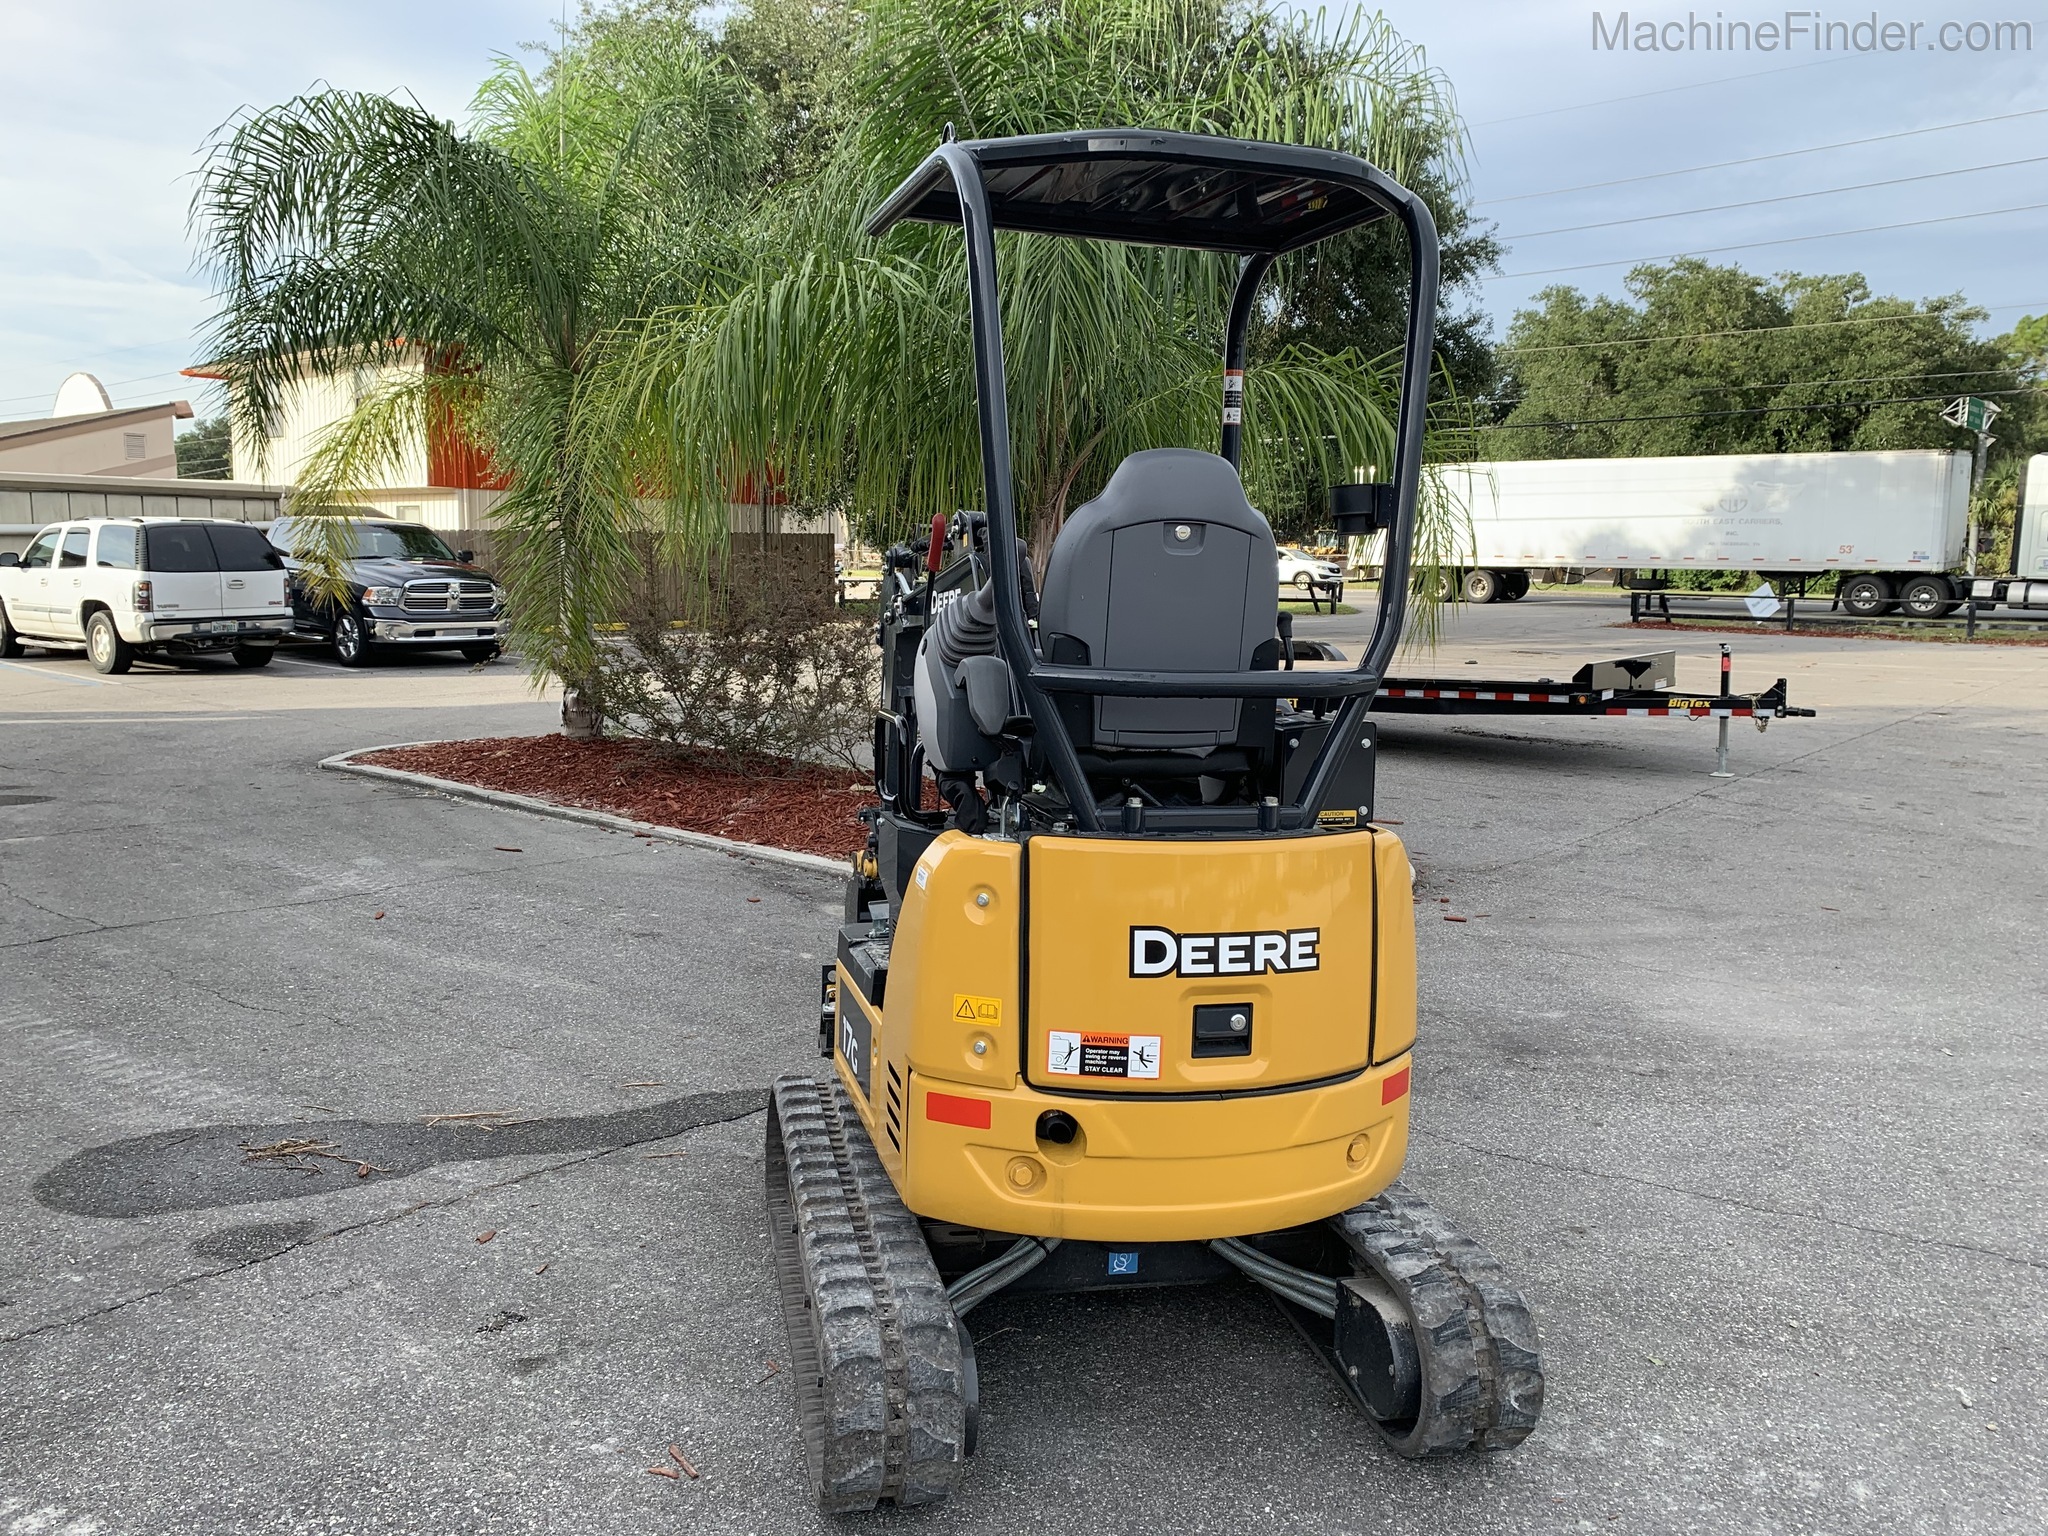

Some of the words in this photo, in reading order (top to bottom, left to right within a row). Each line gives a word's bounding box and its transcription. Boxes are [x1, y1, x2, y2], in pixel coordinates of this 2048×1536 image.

[1667, 698, 1711, 709] BigTex
[1133, 929, 1318, 975] DEERE
[1090, 1035, 1128, 1045] WARNING
